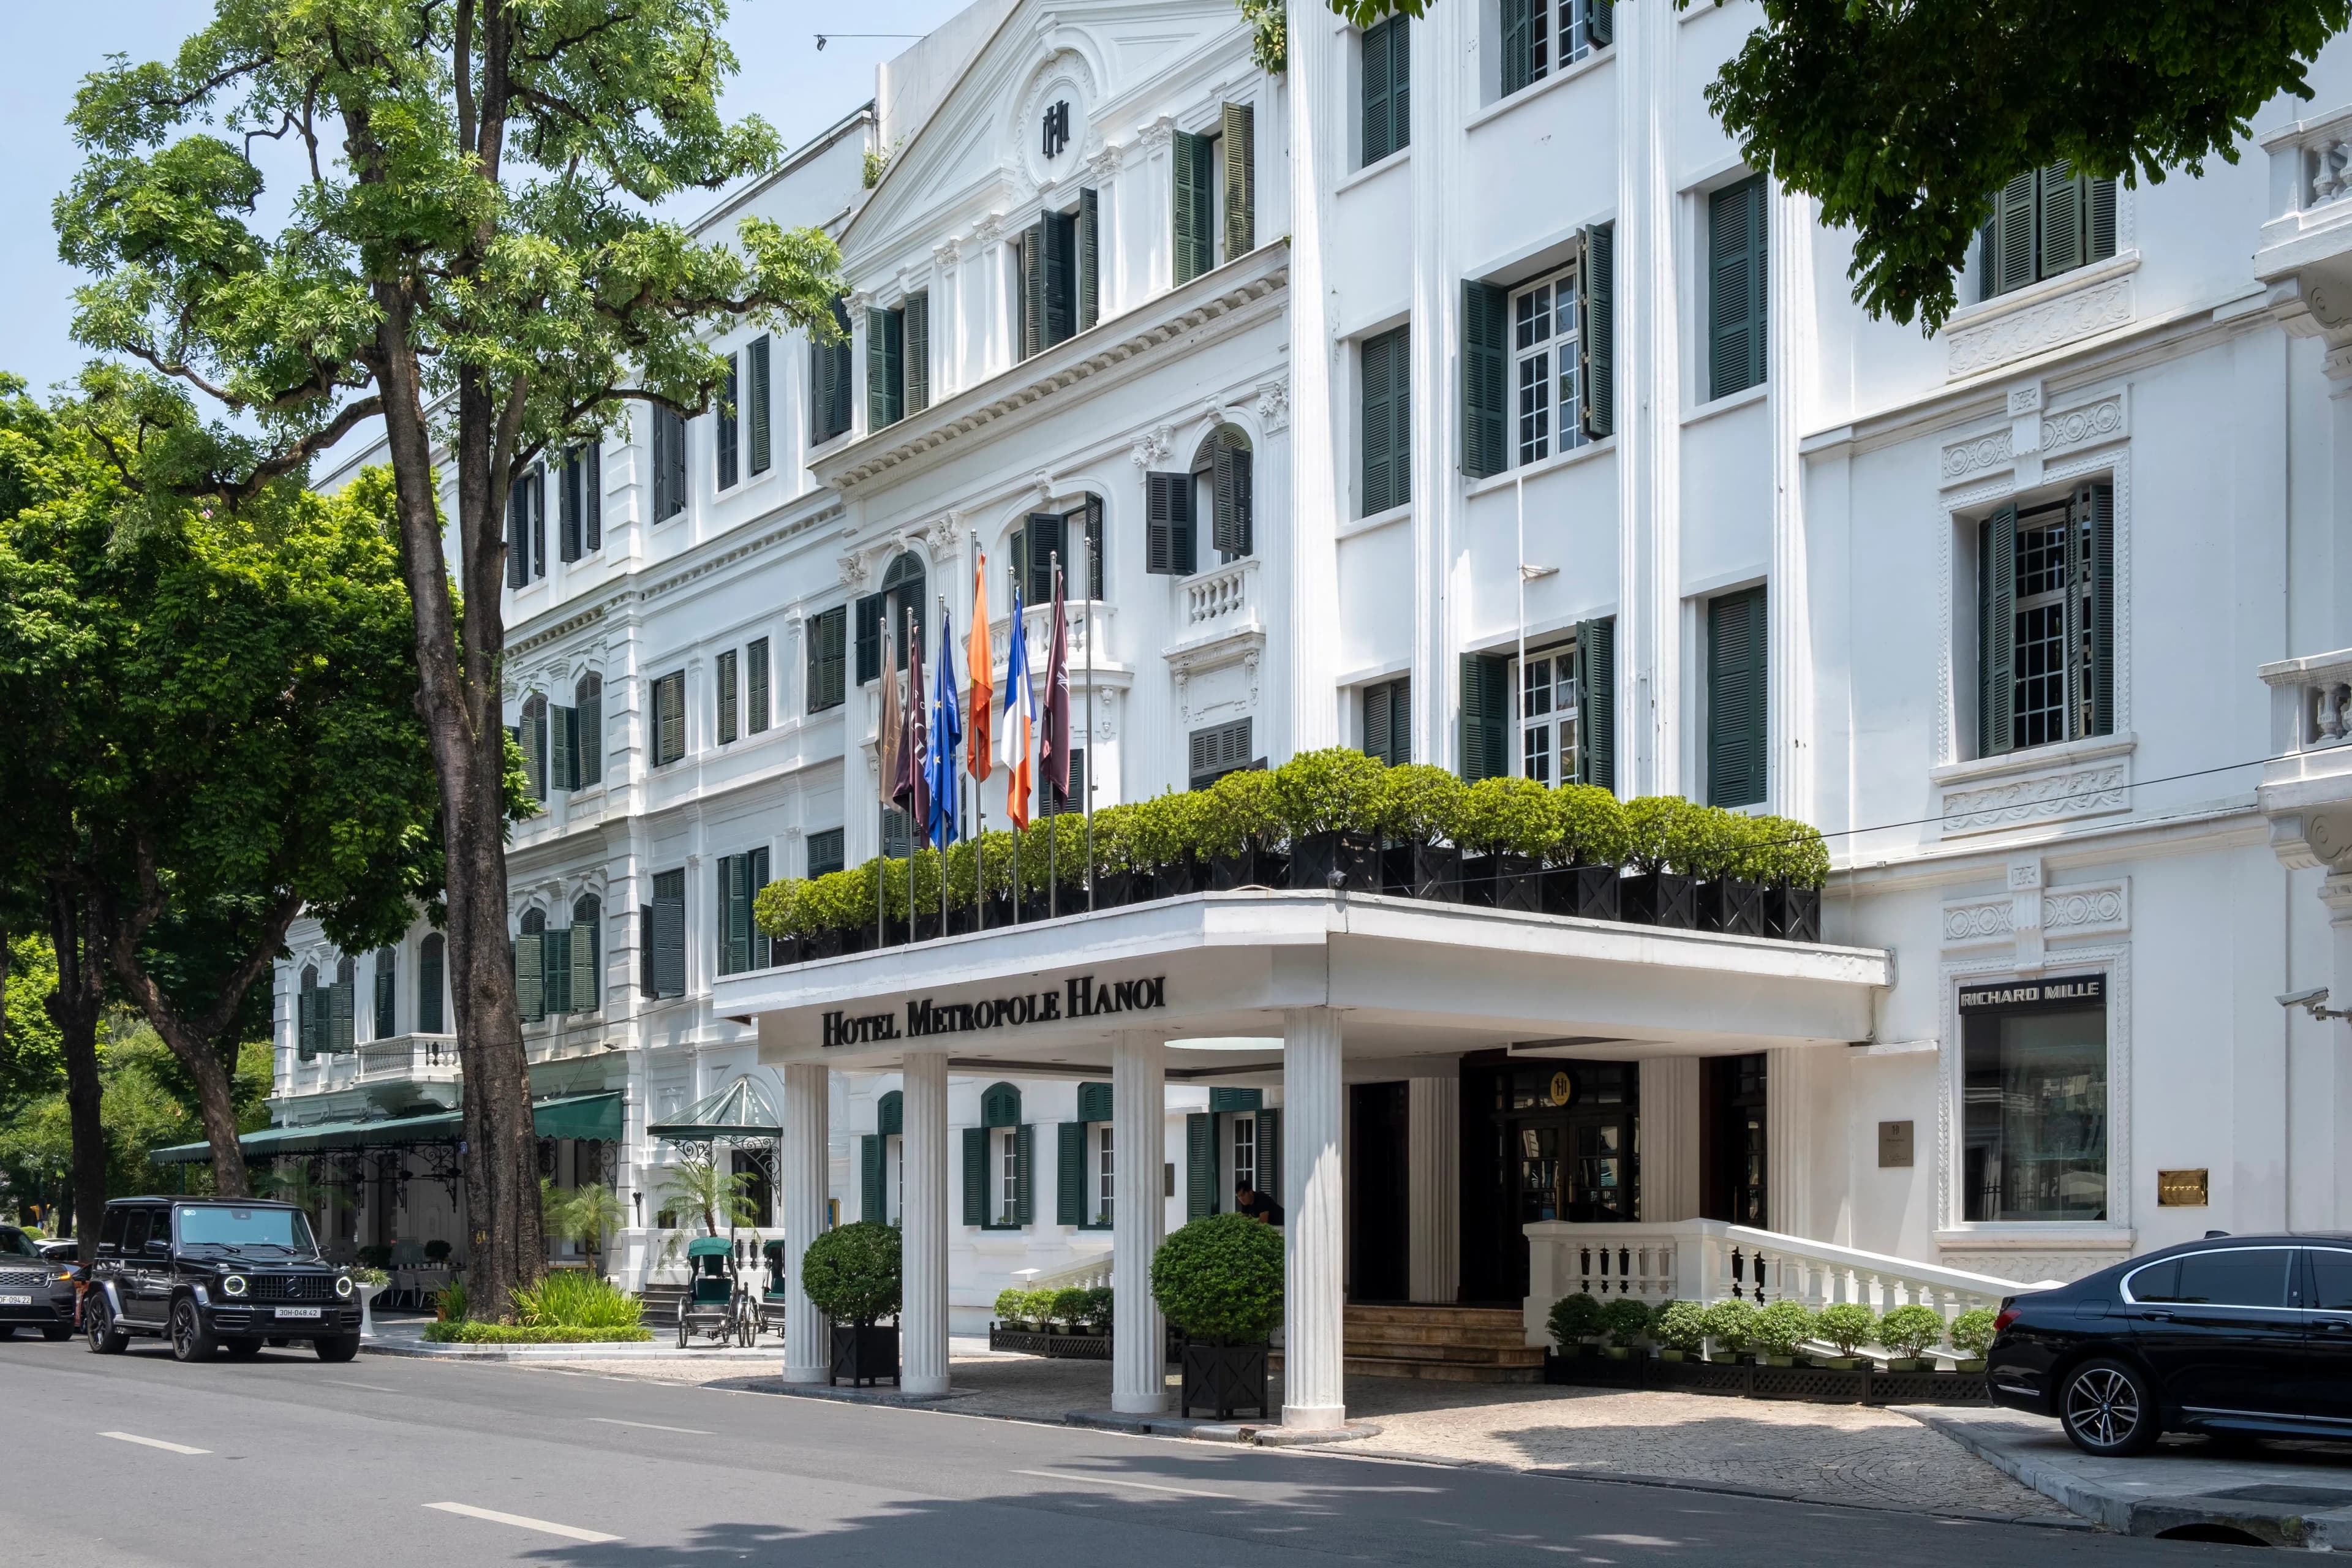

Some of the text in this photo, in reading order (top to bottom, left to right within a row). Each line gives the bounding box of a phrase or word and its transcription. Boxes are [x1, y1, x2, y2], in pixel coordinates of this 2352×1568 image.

[821, 976, 1166, 1047] HOTEL METROPOLE HANOI
[1961, 982, 2100, 1007] RICHARD MILLE
